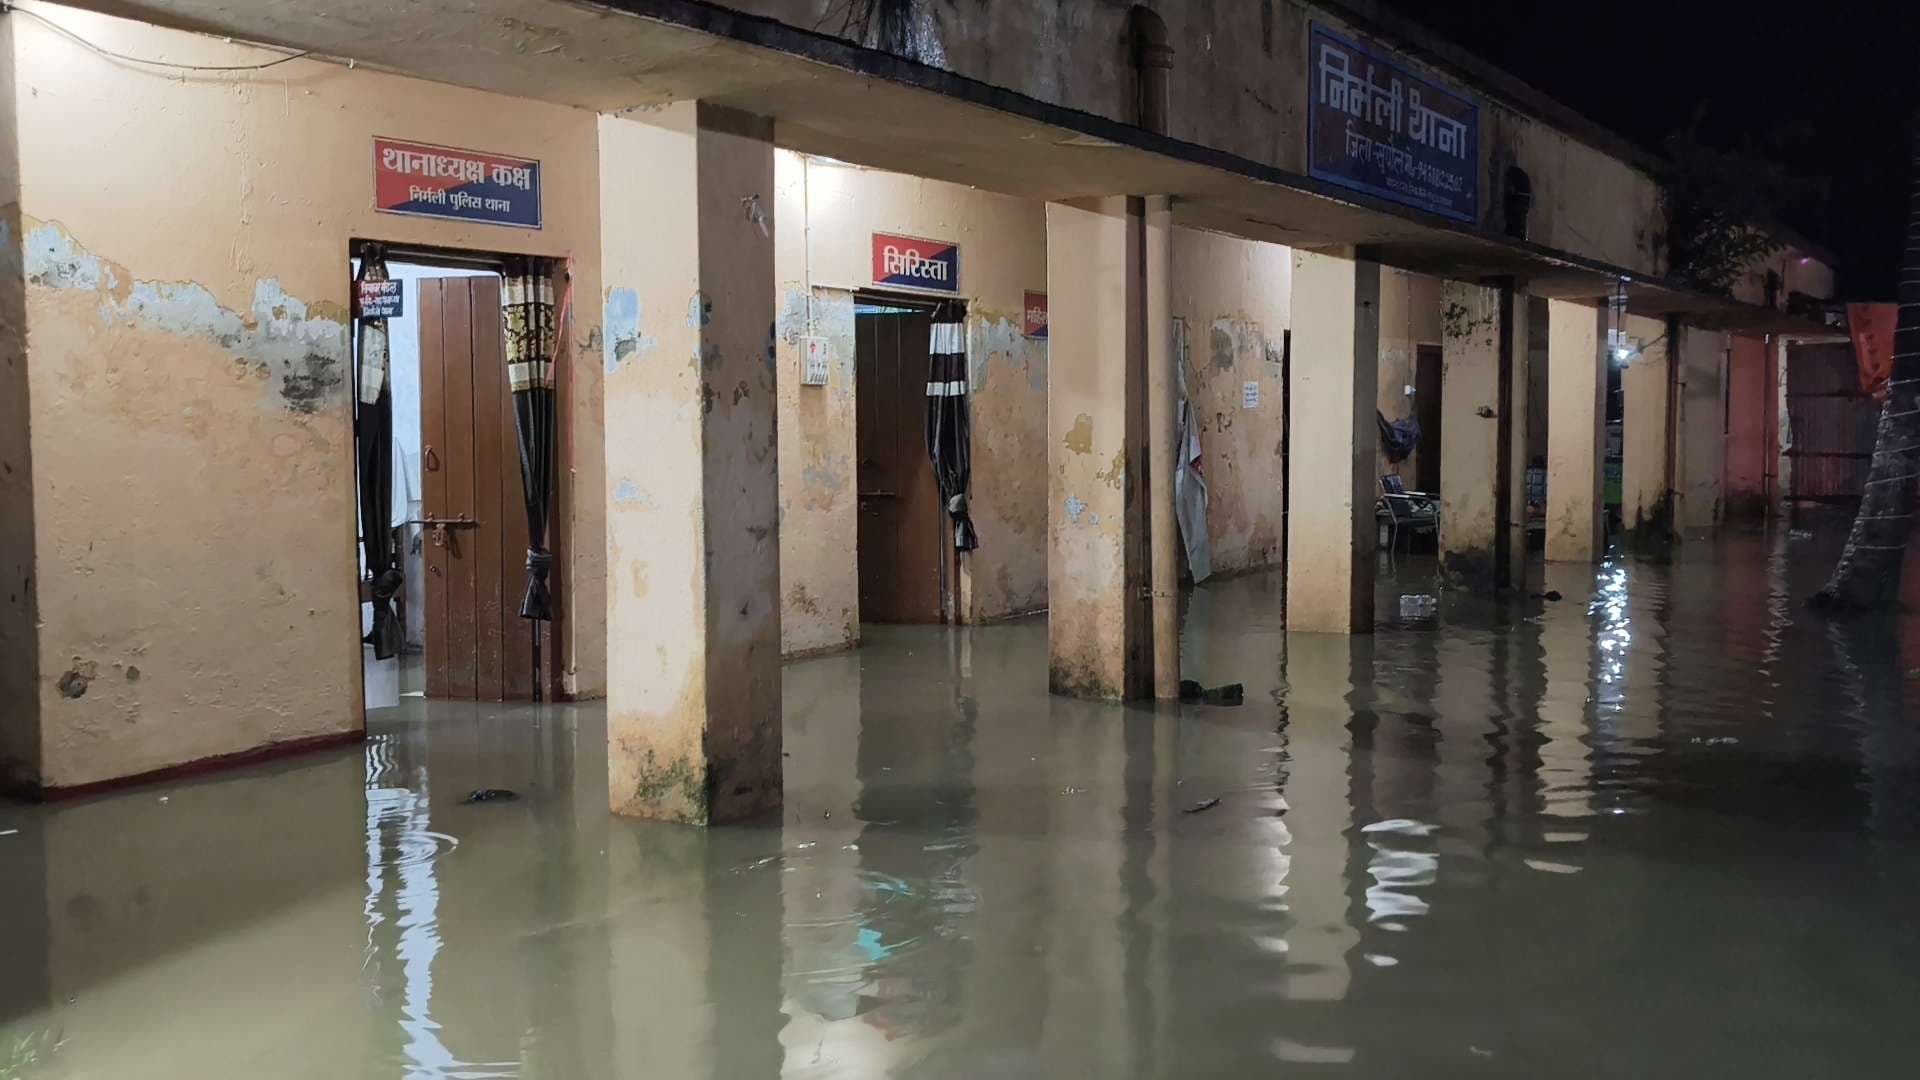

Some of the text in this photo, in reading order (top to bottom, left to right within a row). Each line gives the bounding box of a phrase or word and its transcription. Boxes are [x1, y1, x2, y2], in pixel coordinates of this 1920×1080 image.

[1319, 43, 1468, 159] निर्मली थाना
[382, 147, 531, 190] थानाध्यक्ष कक्ष
[409, 184, 511, 213] निर्मली पुलिस थाना
[883, 245, 949, 281] सिरिस्ता
